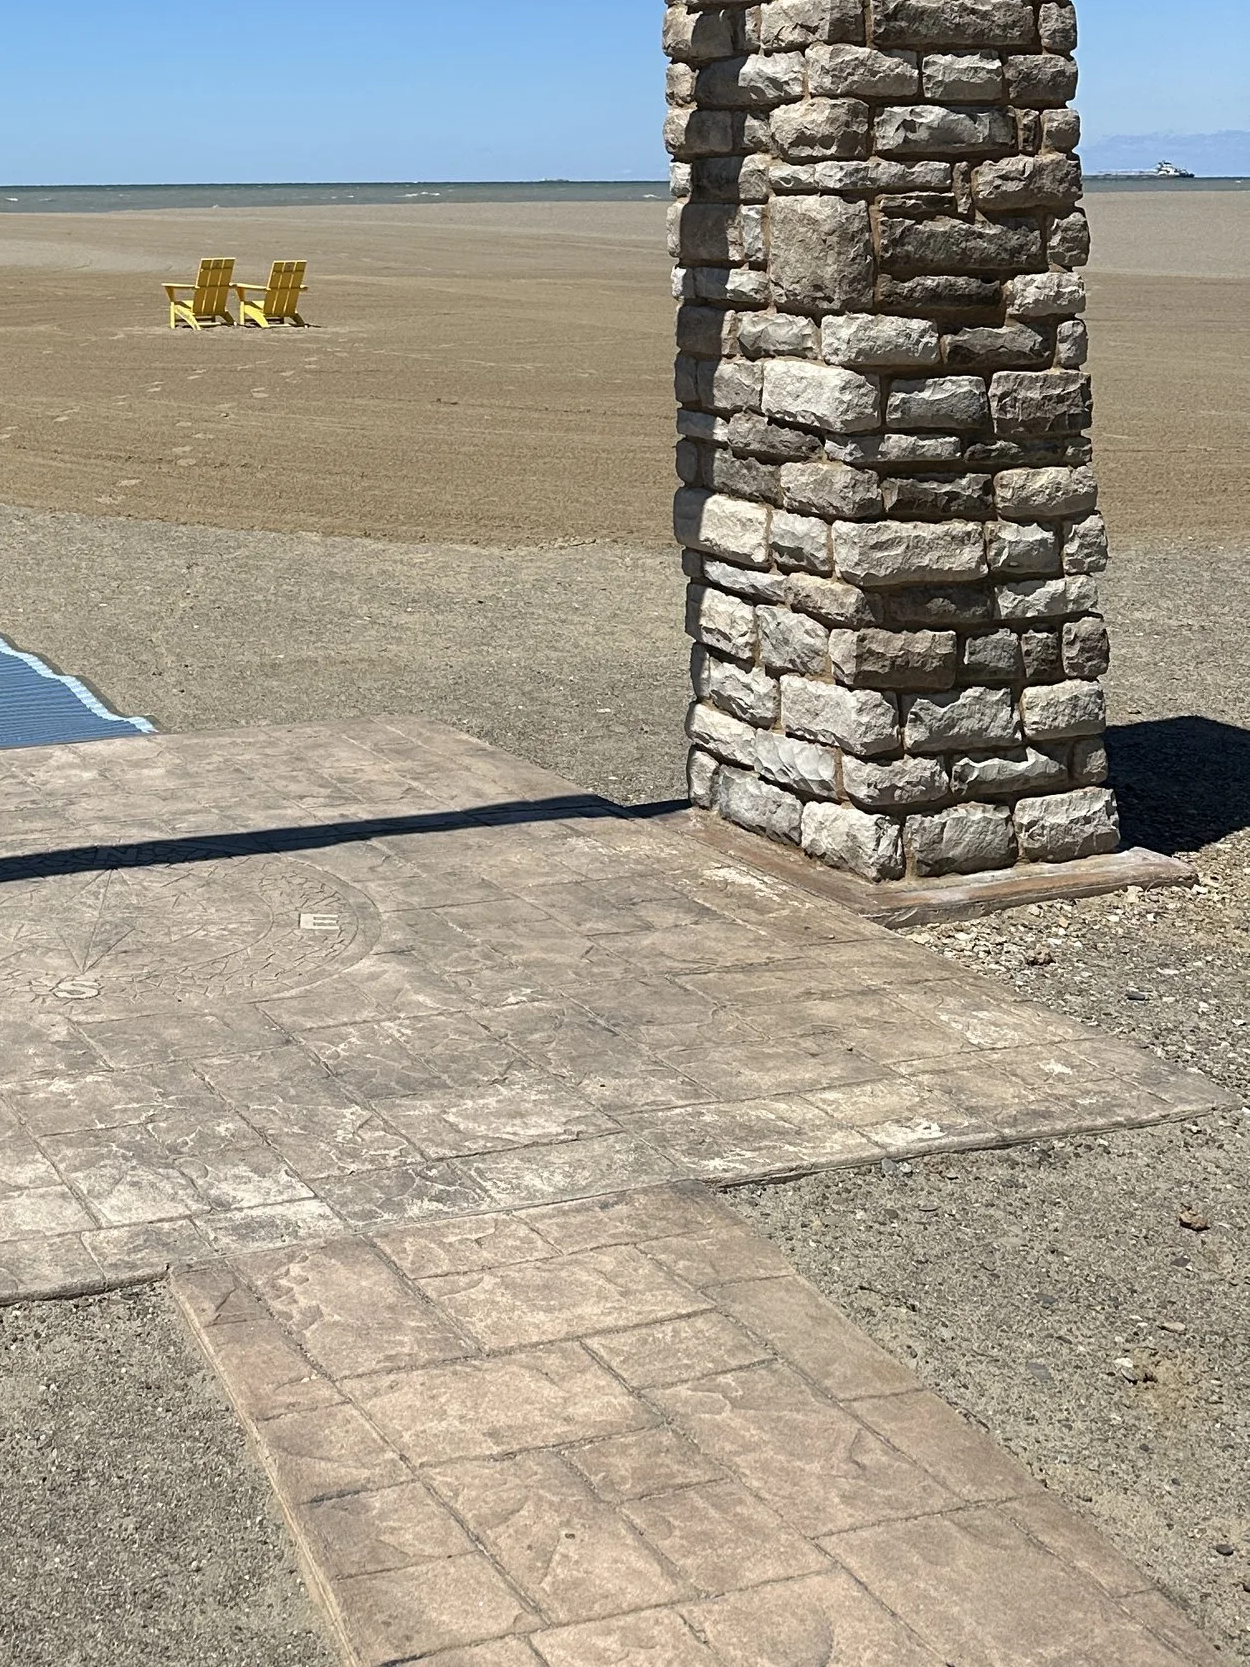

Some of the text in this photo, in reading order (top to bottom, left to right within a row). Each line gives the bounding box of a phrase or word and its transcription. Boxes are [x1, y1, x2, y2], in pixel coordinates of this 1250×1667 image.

[94, 845, 139, 864] N
[300, 913, 340, 930] E
[53, 980, 100, 1000] S
